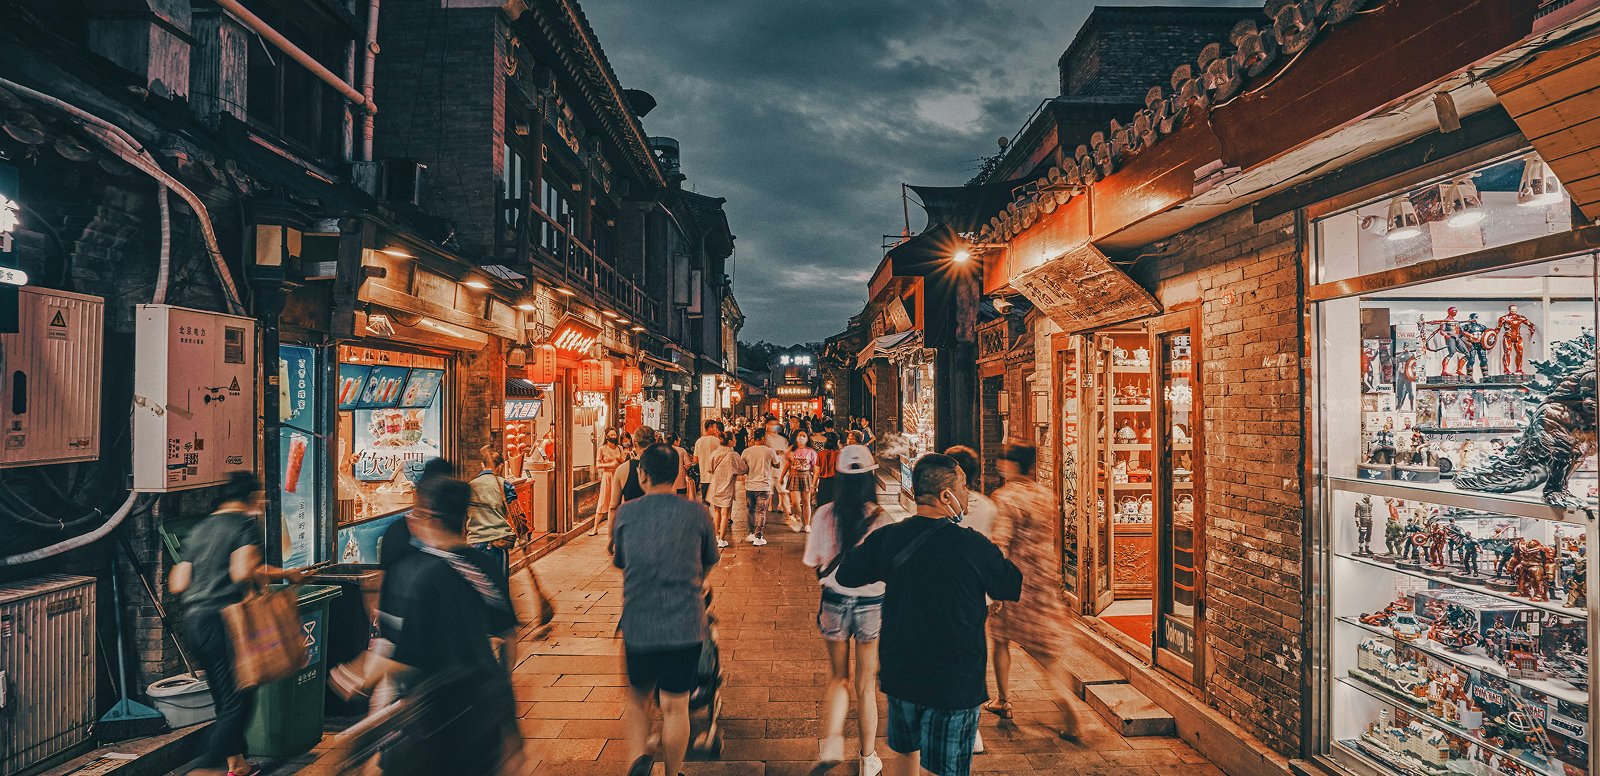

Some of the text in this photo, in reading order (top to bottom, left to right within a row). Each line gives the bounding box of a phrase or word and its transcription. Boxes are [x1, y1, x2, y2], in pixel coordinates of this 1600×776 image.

[179, 325, 206, 337] 北京电力
[360, 448, 425, 476] 饮冰吧
[1165, 619, 1184, 654] Oolong
